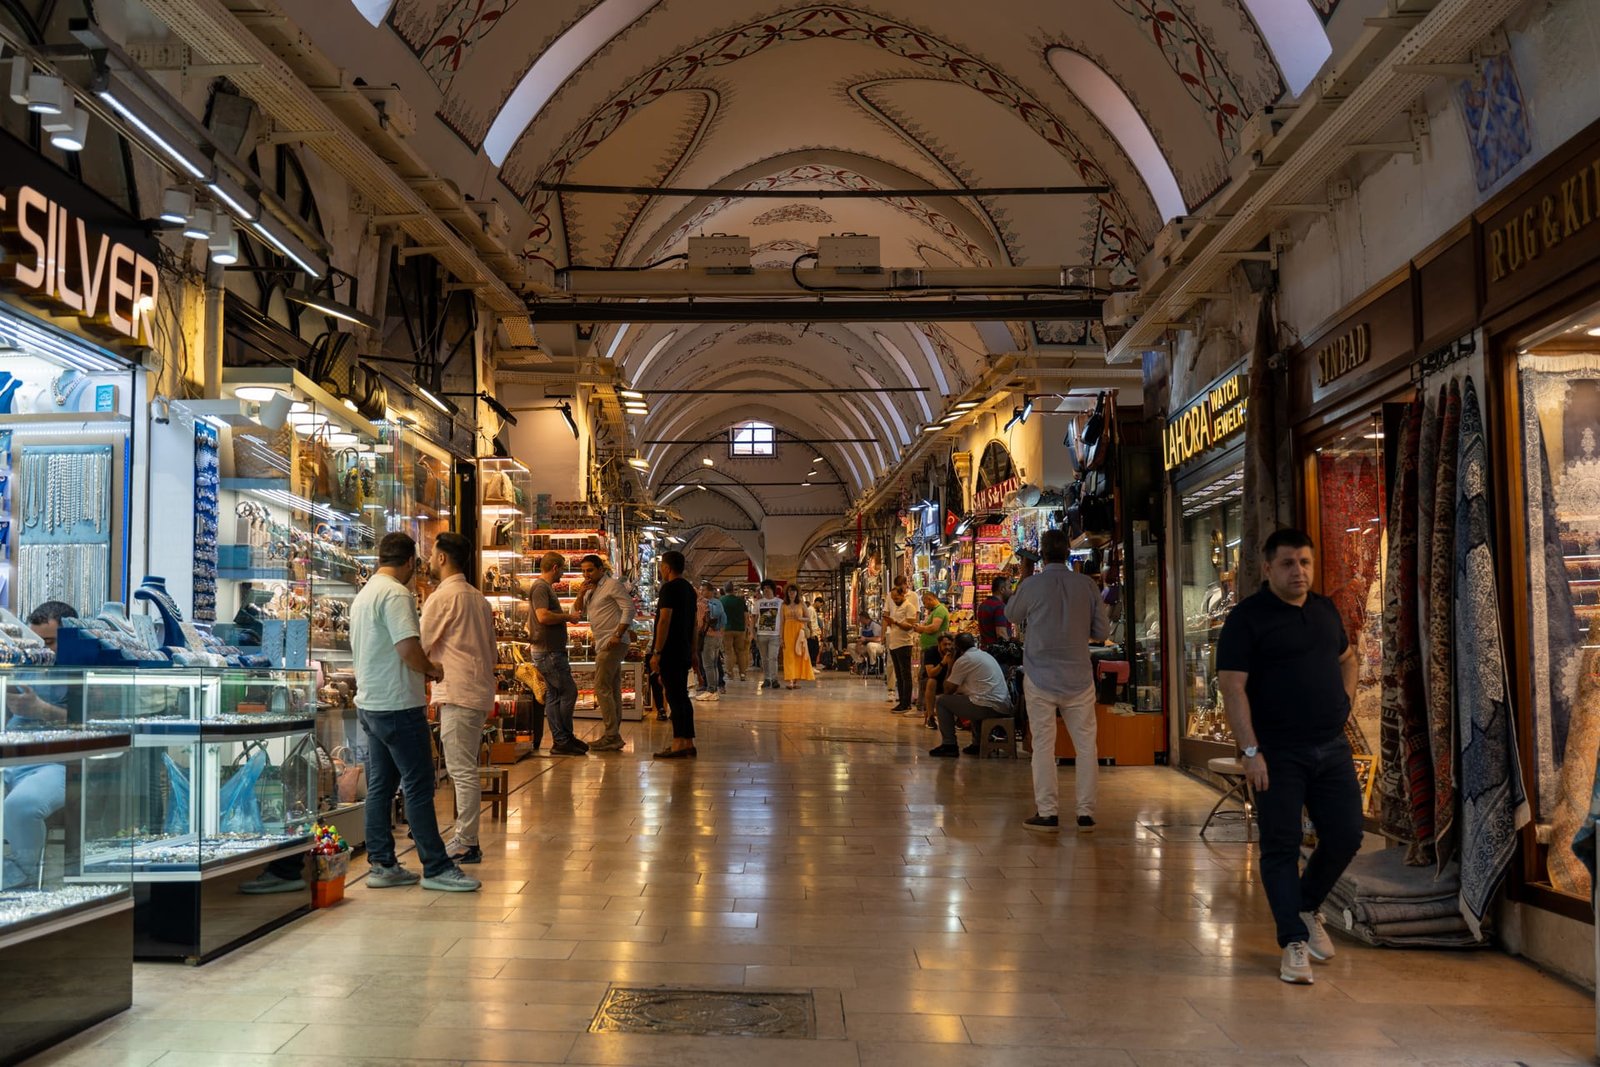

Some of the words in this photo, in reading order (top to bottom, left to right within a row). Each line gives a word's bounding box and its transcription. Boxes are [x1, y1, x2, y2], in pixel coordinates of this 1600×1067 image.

[15, 185, 159, 349] SILVER
[1317, 324, 1366, 388] SINBAD
[1210, 375, 1239, 412] WATCH
[1163, 400, 1210, 471] LAHORA
